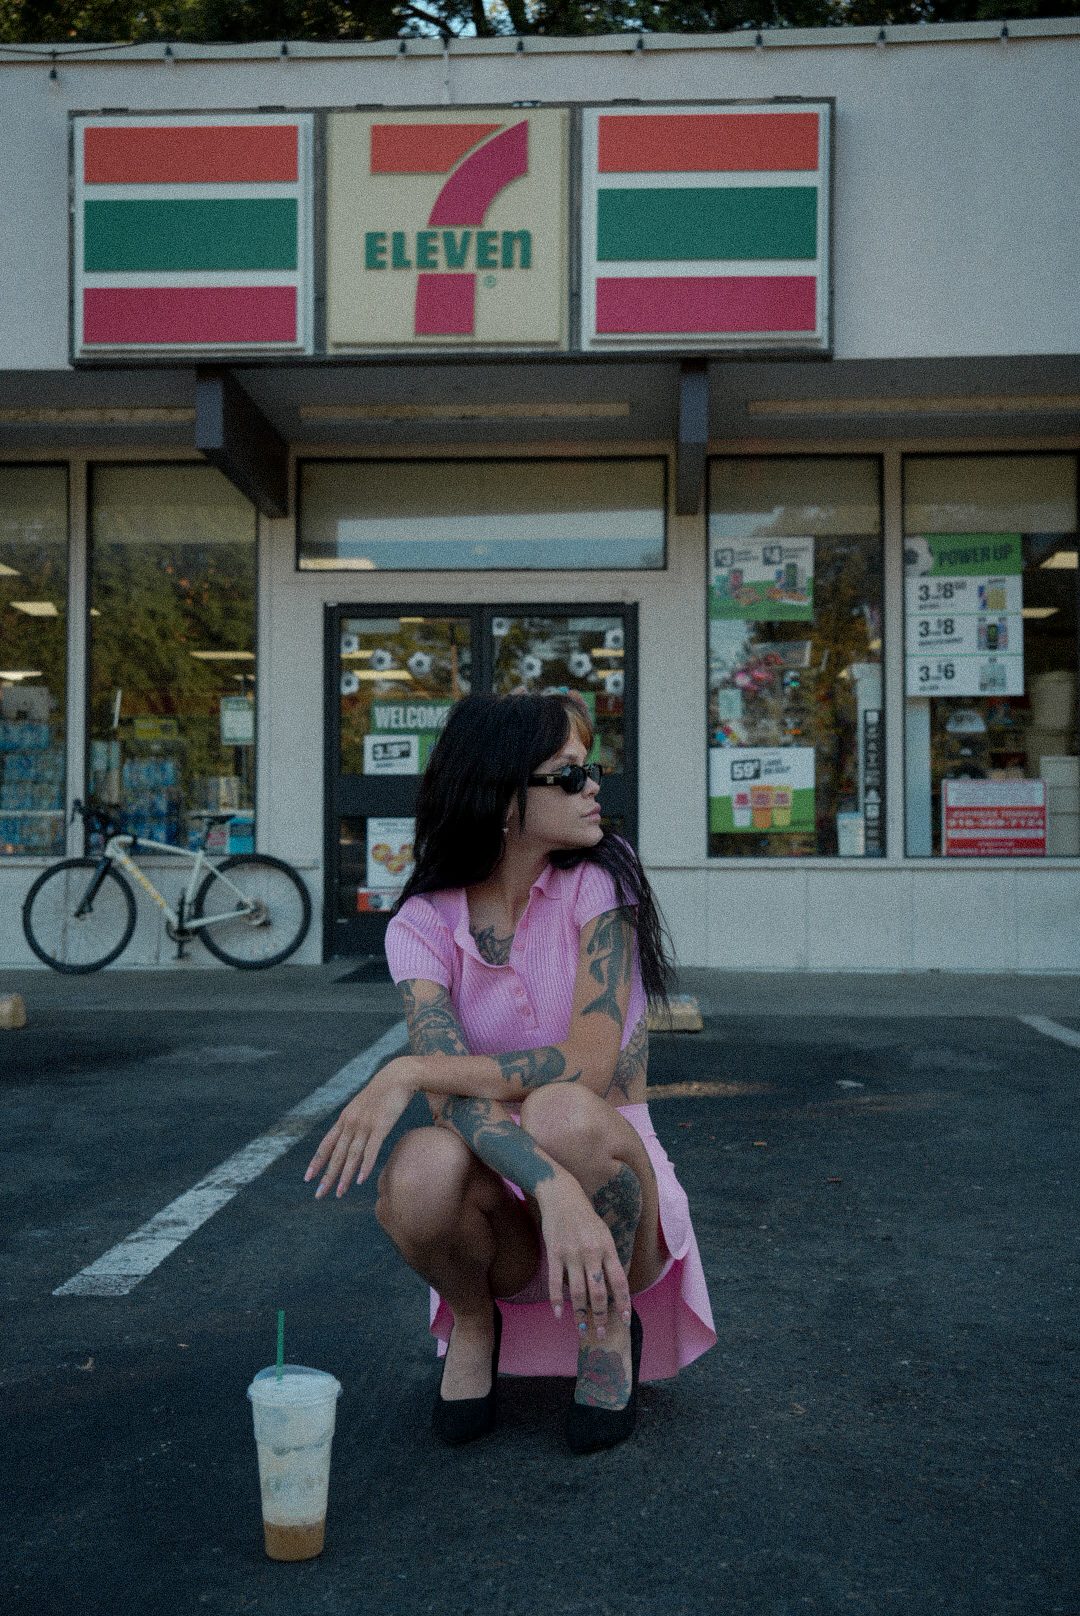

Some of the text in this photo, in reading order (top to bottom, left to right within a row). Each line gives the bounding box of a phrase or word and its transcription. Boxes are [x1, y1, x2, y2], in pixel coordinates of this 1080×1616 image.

[370, 119, 529, 335] 7
[940, 544, 1012, 566] POWER UP
